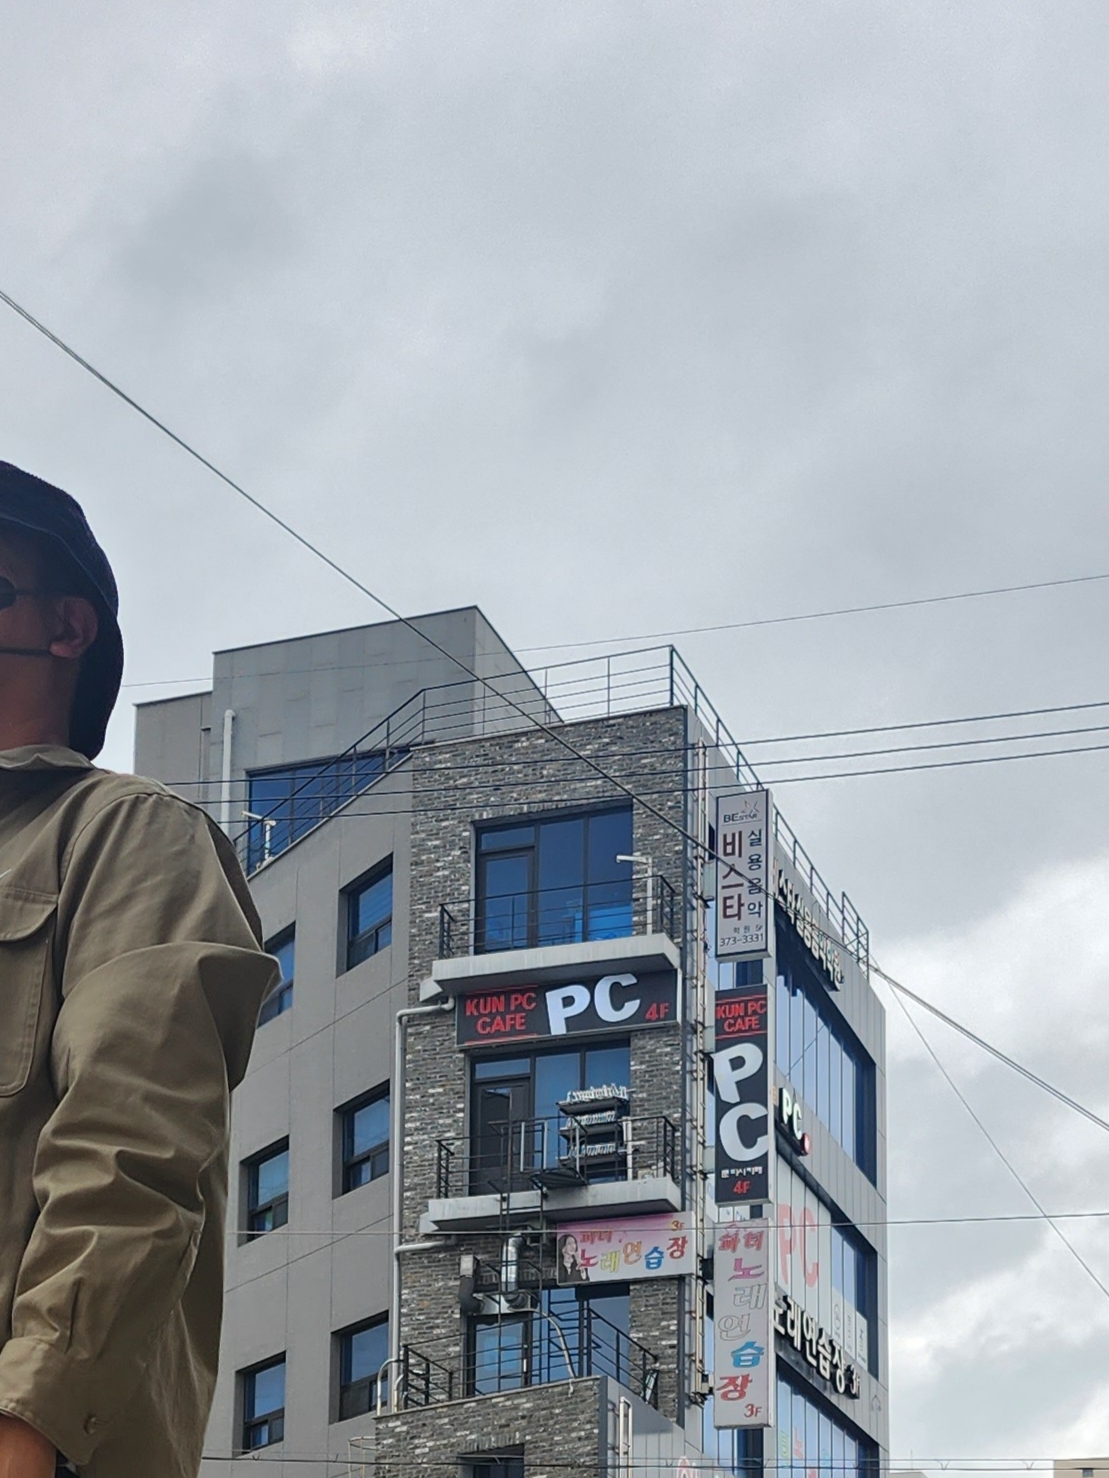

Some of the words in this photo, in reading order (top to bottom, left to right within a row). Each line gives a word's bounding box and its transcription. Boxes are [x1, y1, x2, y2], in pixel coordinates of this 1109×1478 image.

[721, 830, 745, 921] 비스타
[747, 829, 763, 918] 실용음악
[719, 933, 764, 947] 373-3331
[465, 994, 507, 1017] KUN
[510, 992, 537, 1011] PC
[545, 973, 641, 1036] PC
[645, 1002, 670, 1022] 4F
[716, 1003, 745, 1020] KUN
[747, 1000, 767, 1016] PC
[476, 1013, 527, 1035] CAFE
[723, 1016, 761, 1033] CAFE
[711, 1043, 769, 1162] PC
[779, 1087, 804, 1141] PC
[733, 1180, 751, 1194] 4F
[579, 1236, 688, 1273] 노래연습장
[716, 1258, 767, 1401] 노래연습장
[744, 1404, 762, 1418] 3F
